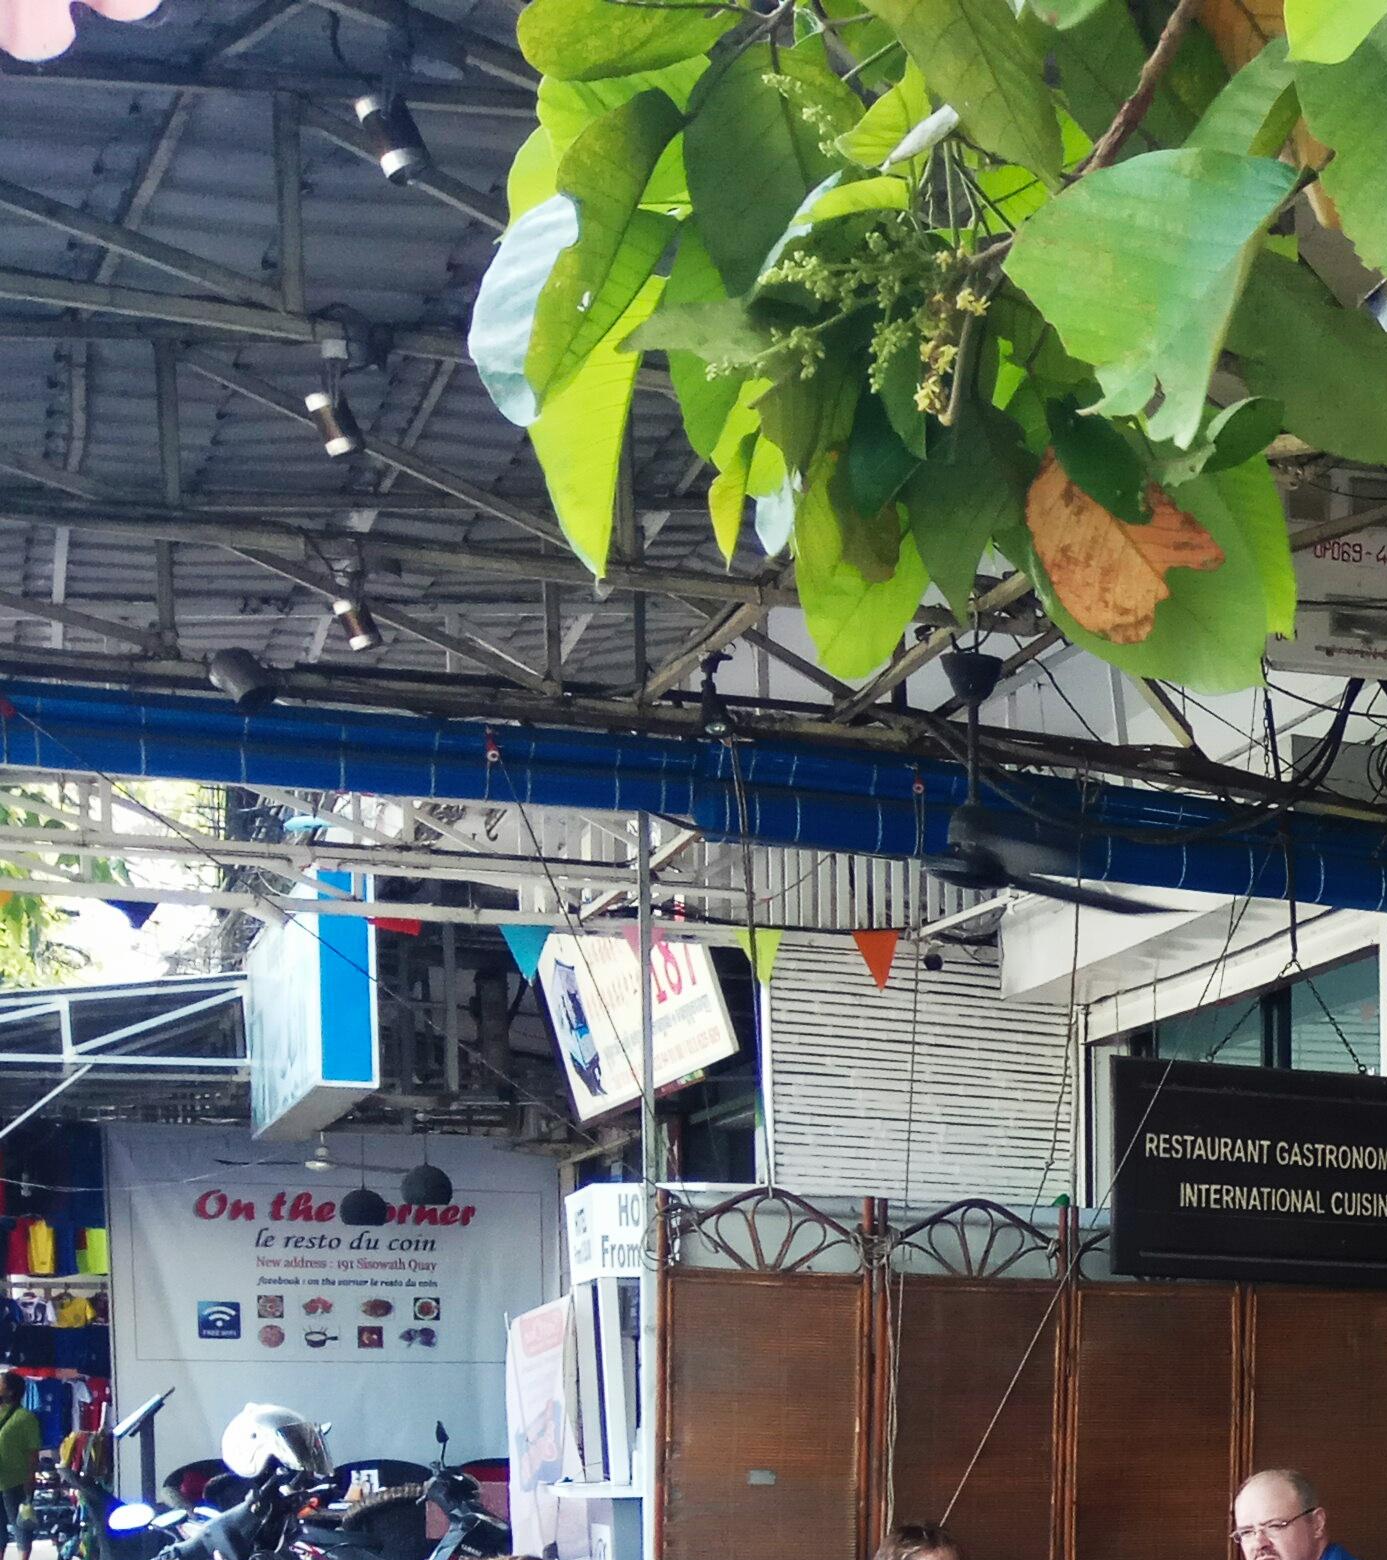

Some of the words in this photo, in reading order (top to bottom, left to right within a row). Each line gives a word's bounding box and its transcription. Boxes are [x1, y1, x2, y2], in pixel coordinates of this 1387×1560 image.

[1145, 1132, 1272, 1165] RESTAURANT
[193, 1188, 256, 1222] On
[268, 1190, 336, 1223] the
[1179, 1182, 1325, 1215] INTERNATIONAL
[254, 1227, 275, 1250] le
[284, 1234, 341, 1250] resto
[350, 1230, 380, 1251] du
[388, 1233, 438, 1251] coin
[256, 1256, 282, 1269] New
[283, 1256, 327, 1269] address
[337, 1258, 354, 1271] 191
[356, 1256, 406, 1271] Sisowath
[408, 1258, 437, 1272] Quay
